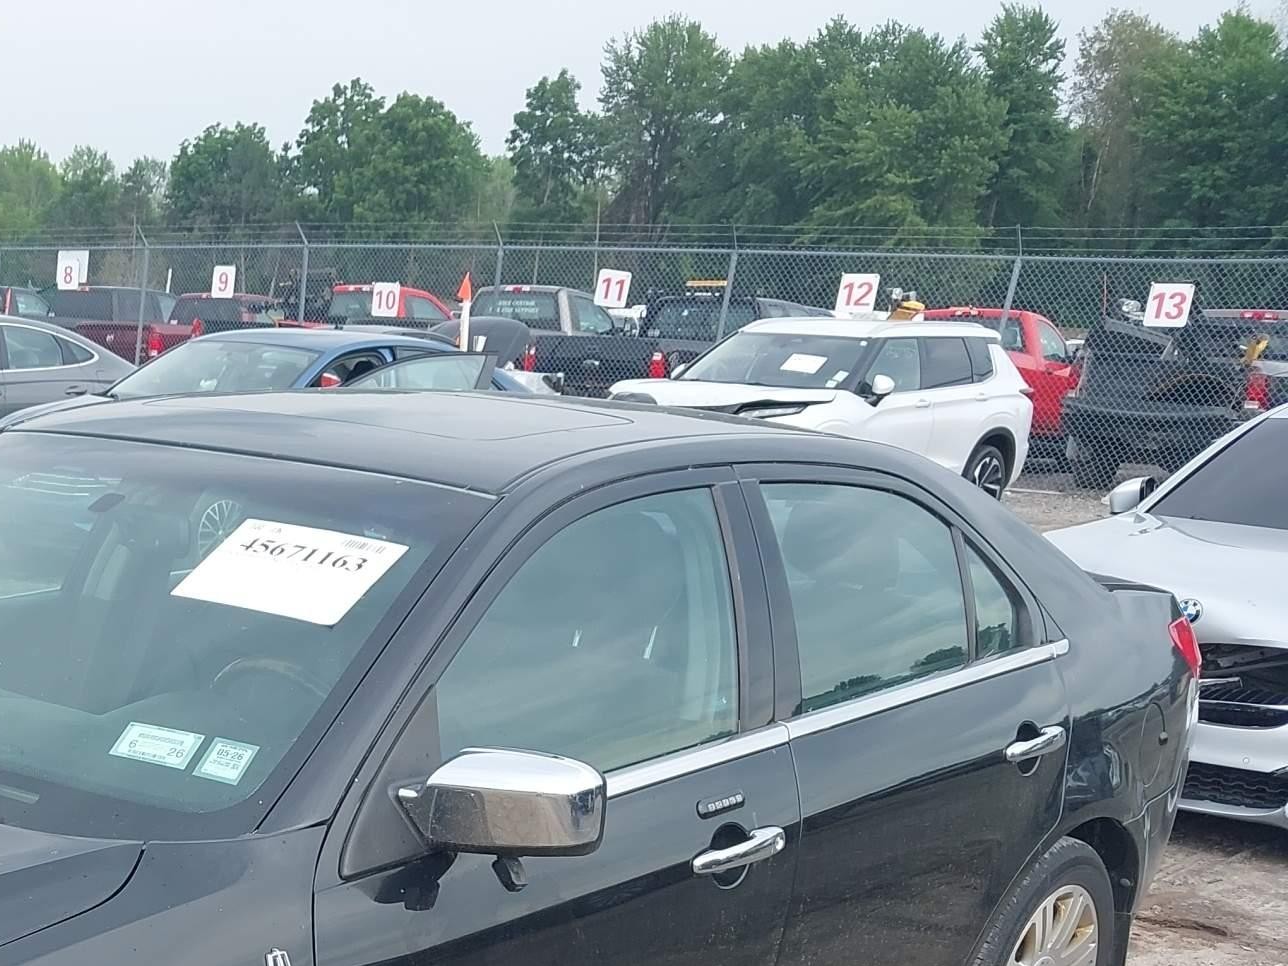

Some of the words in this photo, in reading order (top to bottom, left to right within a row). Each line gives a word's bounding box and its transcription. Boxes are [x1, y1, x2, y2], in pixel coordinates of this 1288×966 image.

[63, 265, 73, 284] 8
[218, 271, 229, 292] 9
[375, 289, 397, 310] 10
[601, 276, 627, 302] 11
[842, 280, 875, 308] 12
[1151, 291, 1188, 320] 13
[239, 537, 368, 572] 45671163
[166, 747, 186, 759] 26
